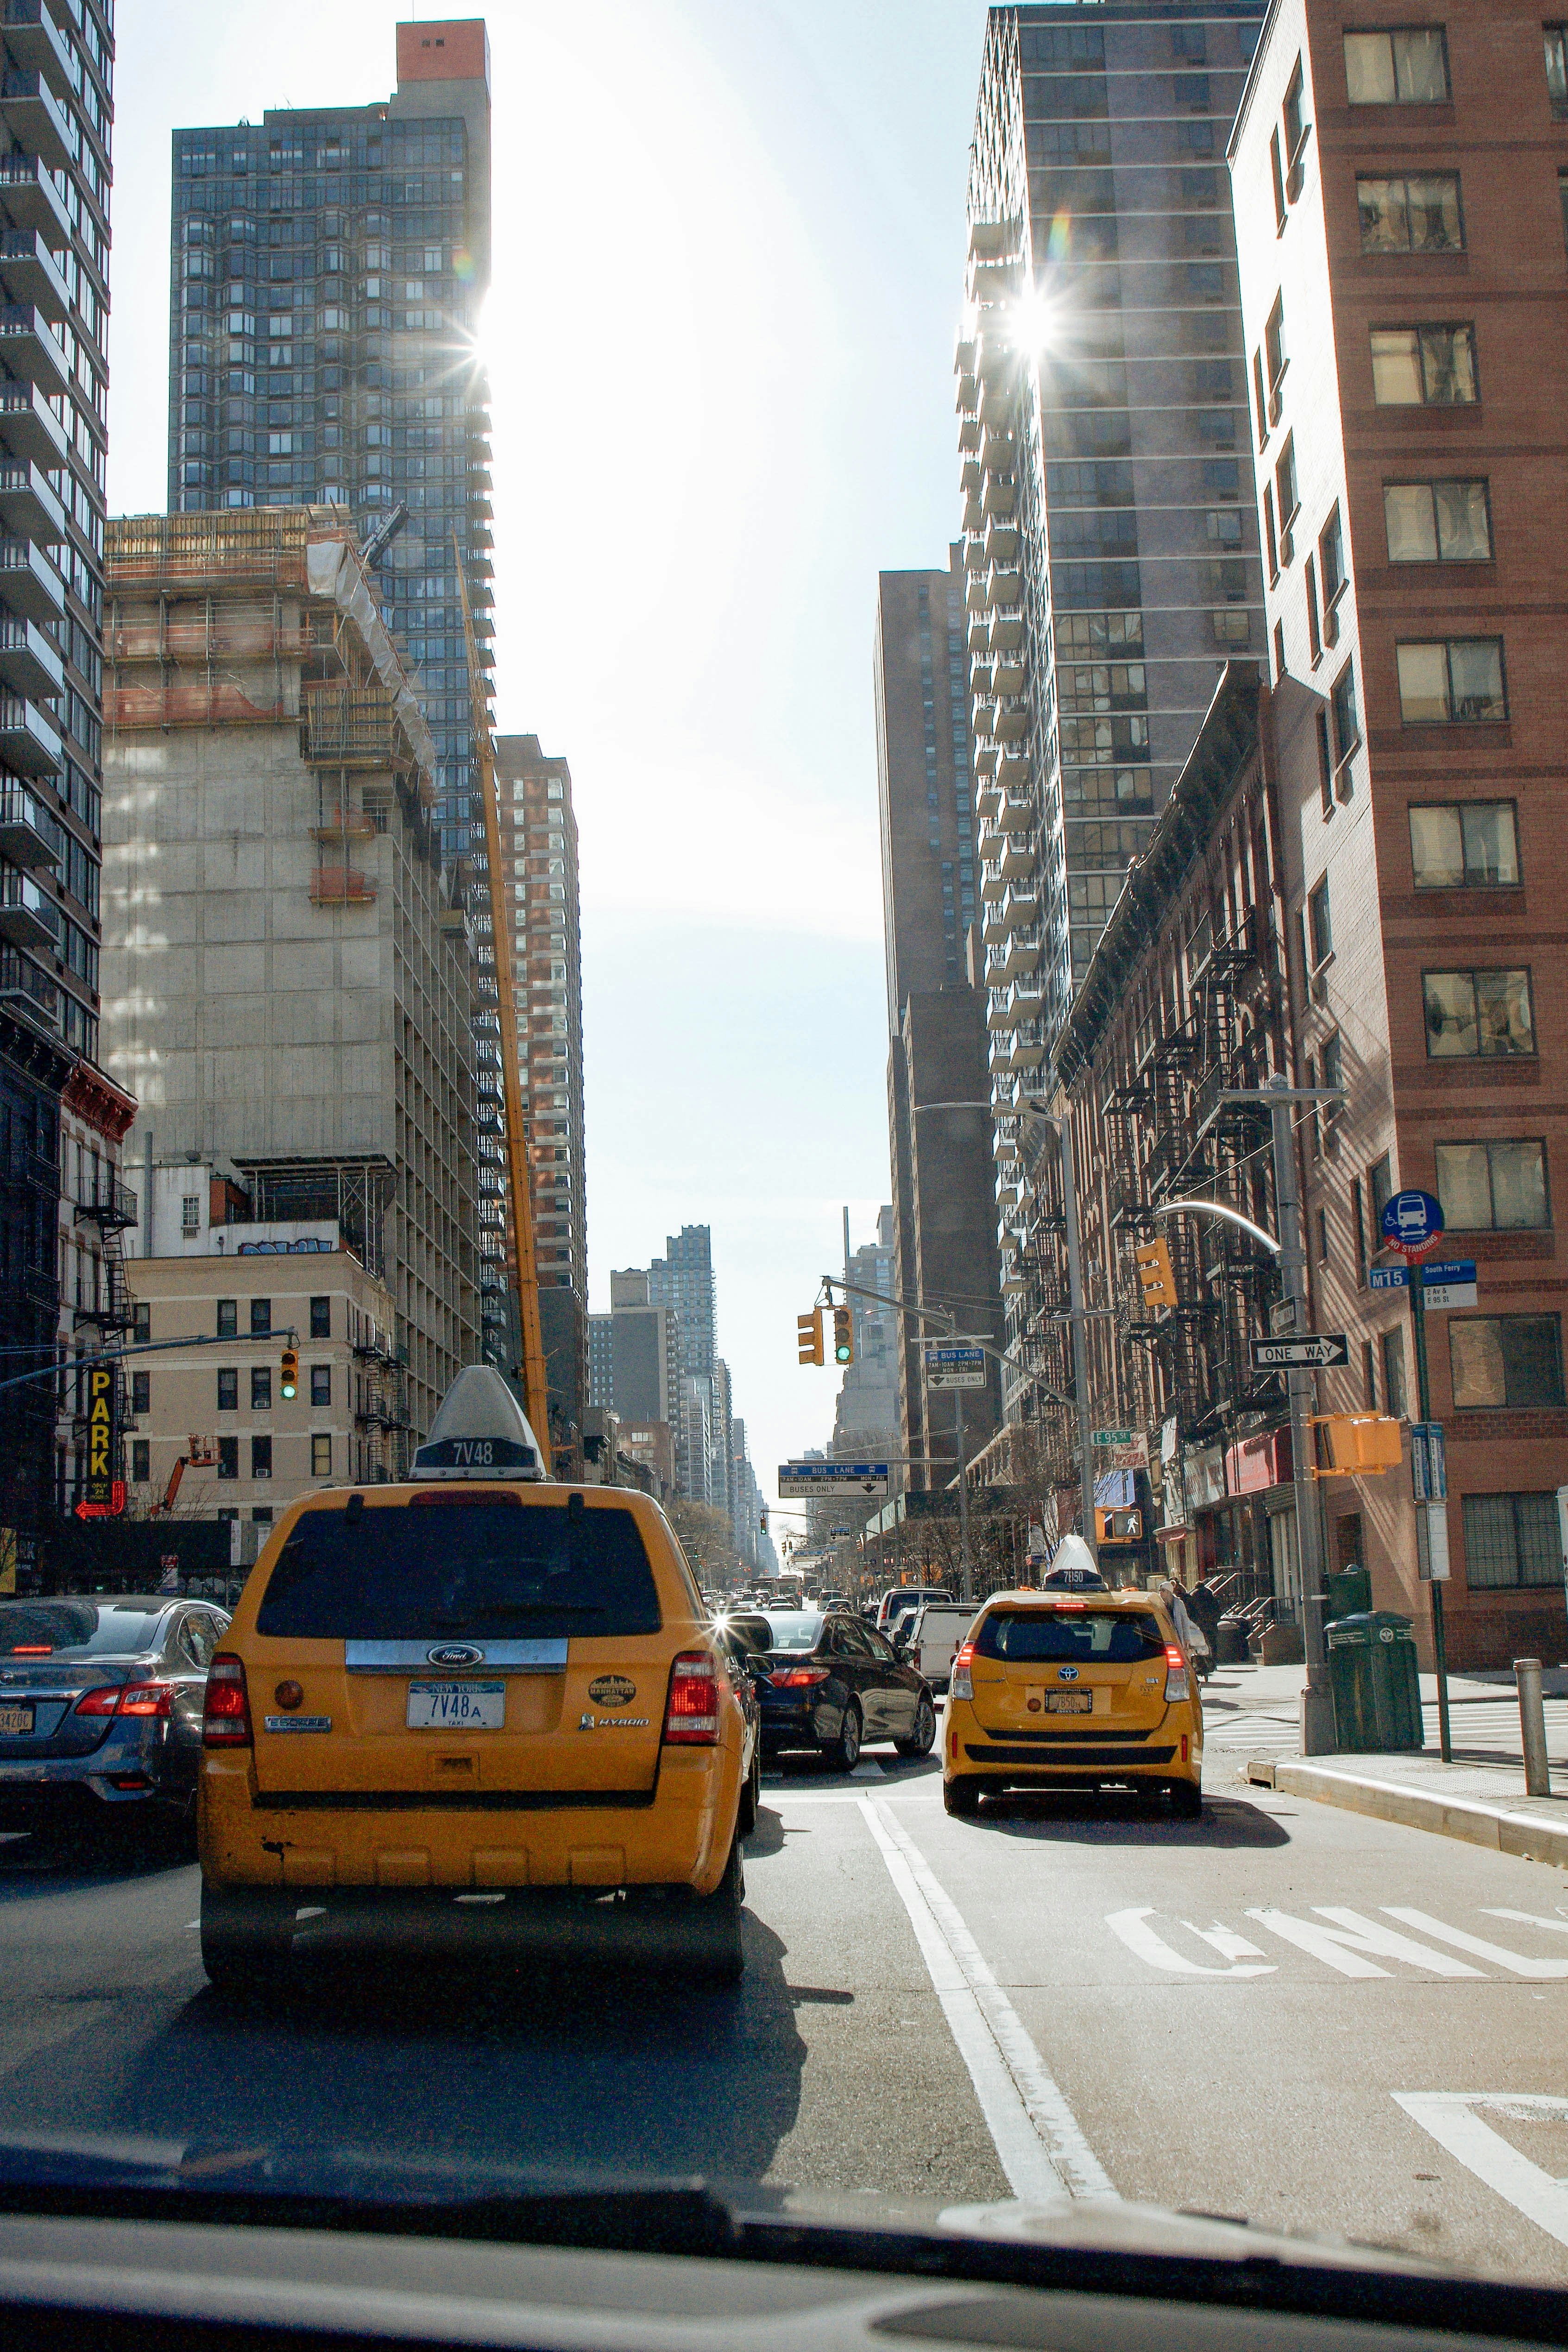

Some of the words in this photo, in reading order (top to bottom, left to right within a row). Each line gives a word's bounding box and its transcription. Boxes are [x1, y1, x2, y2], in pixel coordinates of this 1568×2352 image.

[1388, 1239, 1399, 1249] NO
[1402, 1234, 1438, 1253] STANDING
[1373, 1271, 1403, 1287] M15
[1265, 1347, 1292, 1361] ONE
[1304, 1345, 1332, 1358] WAY
[91, 1372, 110, 1476] PARK
[1096, 1433, 1102, 1443] E
[1105, 1432, 1117, 1443] 95
[453, 1442, 492, 1464] 7V48
[1064, 1570, 1083, 1583] 7B50
[442, 1650, 467, 1661] Ford
[432, 1684, 453, 1692] NEW
[457, 1684, 482, 1693] YORK
[268, 1717, 327, 1728] ESCAPE
[598, 1718, 649, 1727] HYBRID
